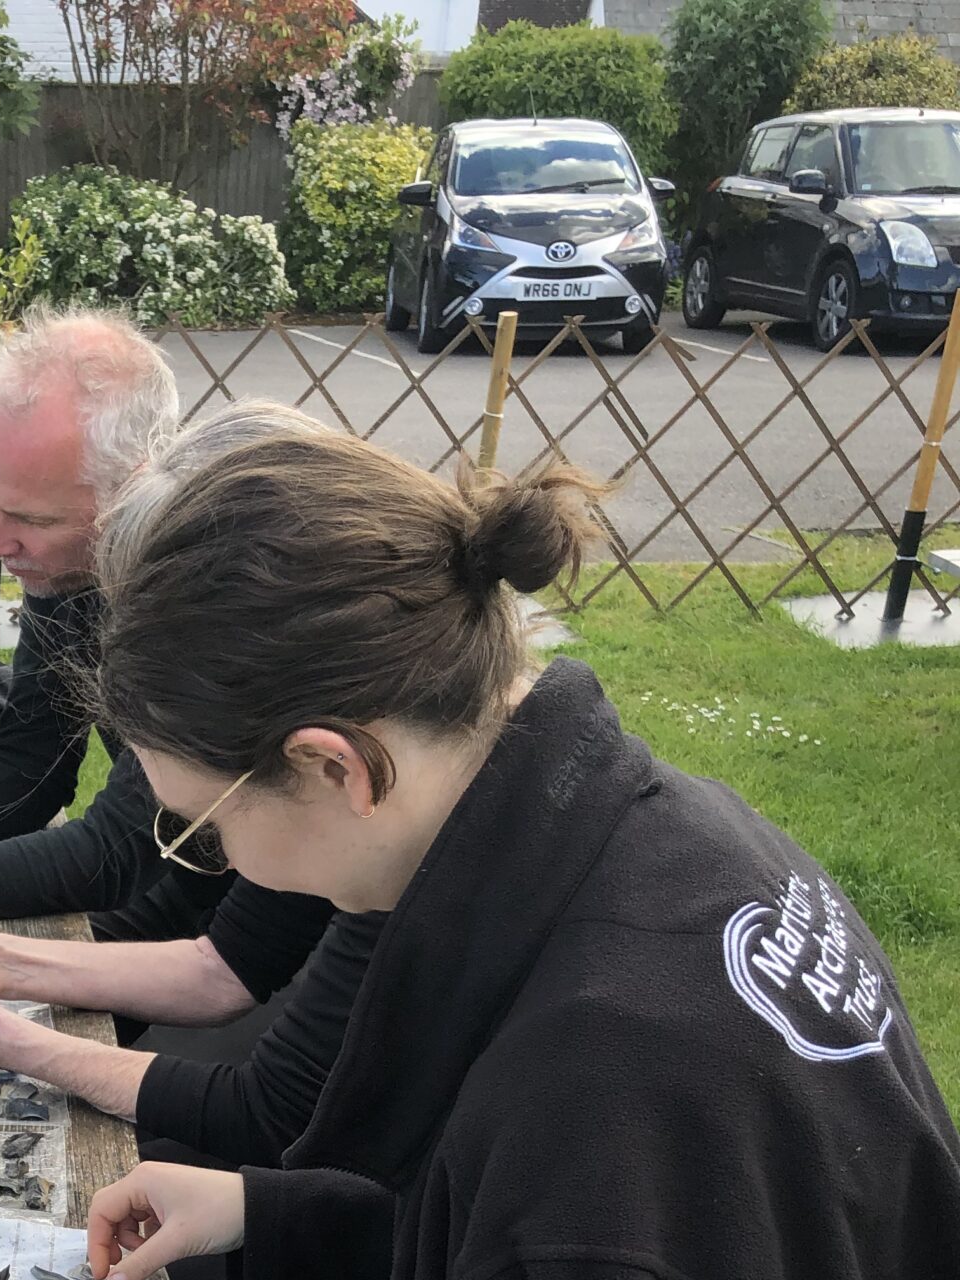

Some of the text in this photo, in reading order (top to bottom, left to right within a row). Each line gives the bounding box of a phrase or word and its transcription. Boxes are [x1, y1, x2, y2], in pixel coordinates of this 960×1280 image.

[523, 283, 592, 297] WR66 ONJ
[751, 870, 810, 990] Maritime
[843, 955, 878, 1031] Trust
